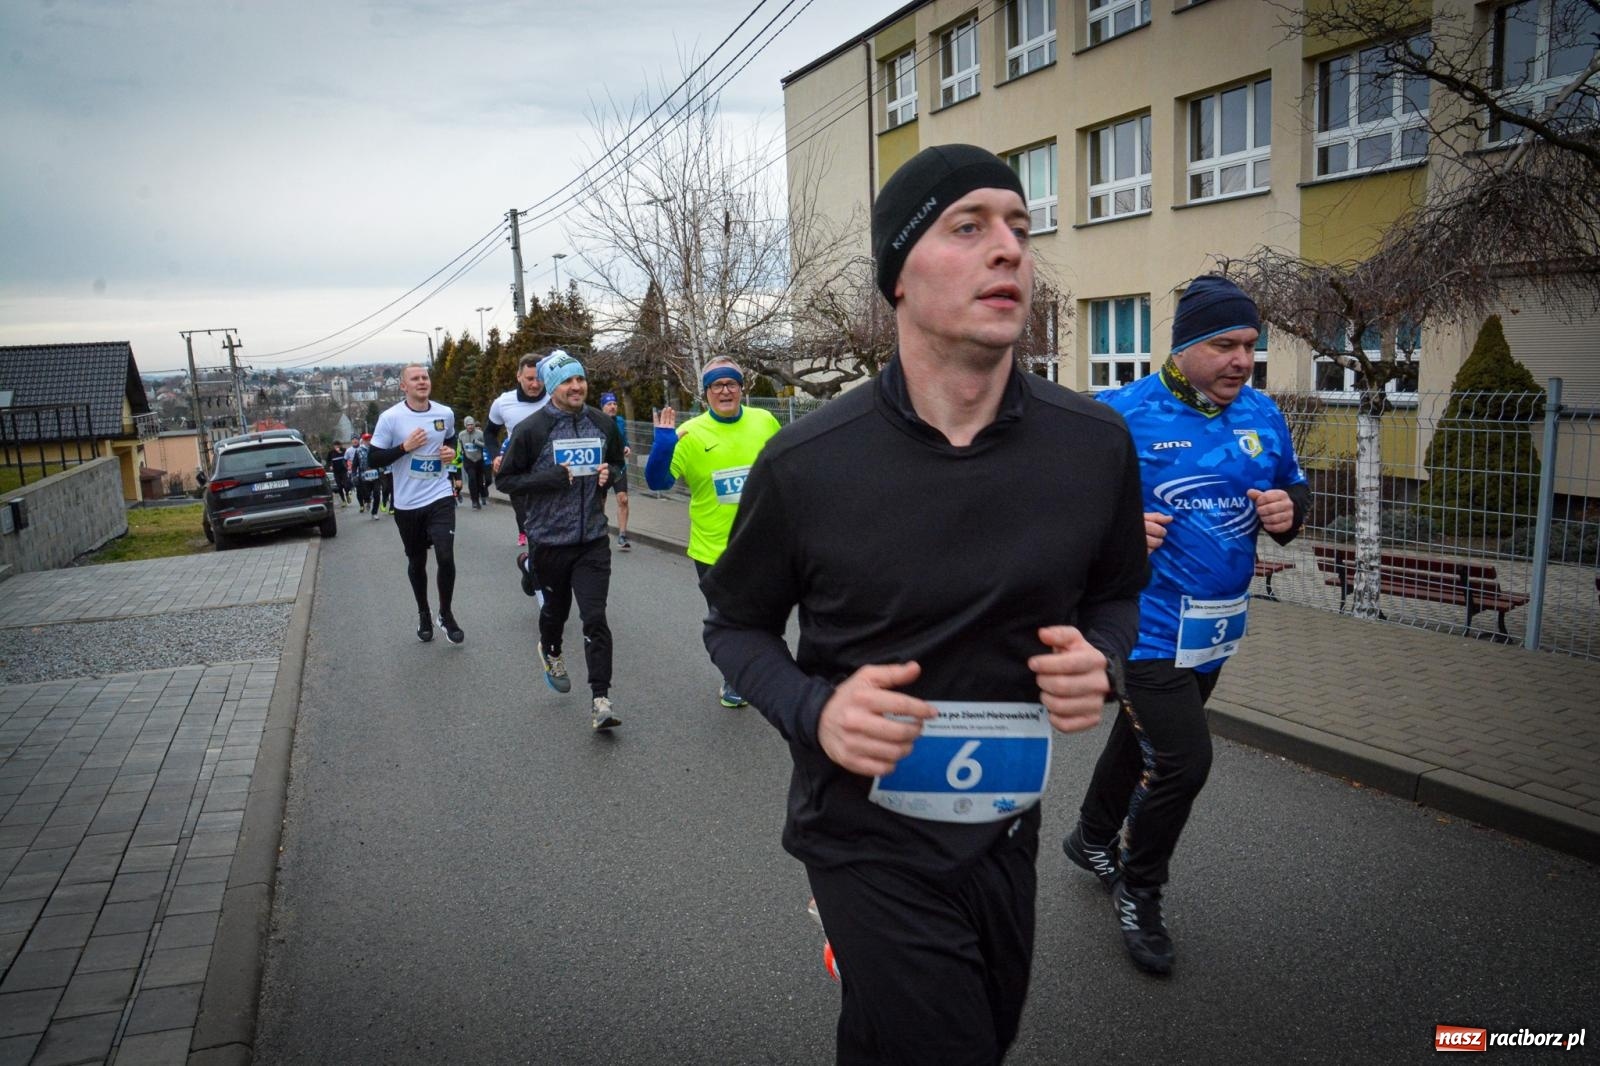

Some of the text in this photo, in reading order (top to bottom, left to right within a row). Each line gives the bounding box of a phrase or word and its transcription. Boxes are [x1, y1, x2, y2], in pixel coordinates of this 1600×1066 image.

[891, 196, 937, 250] KIPRUN
[420, 460, 434, 472] 46
[563, 448, 595, 465] 230
[1174, 497, 1246, 510] ZŁOM-MAX
[1211, 618, 1229, 645] 3
[946, 739, 983, 790] 6
